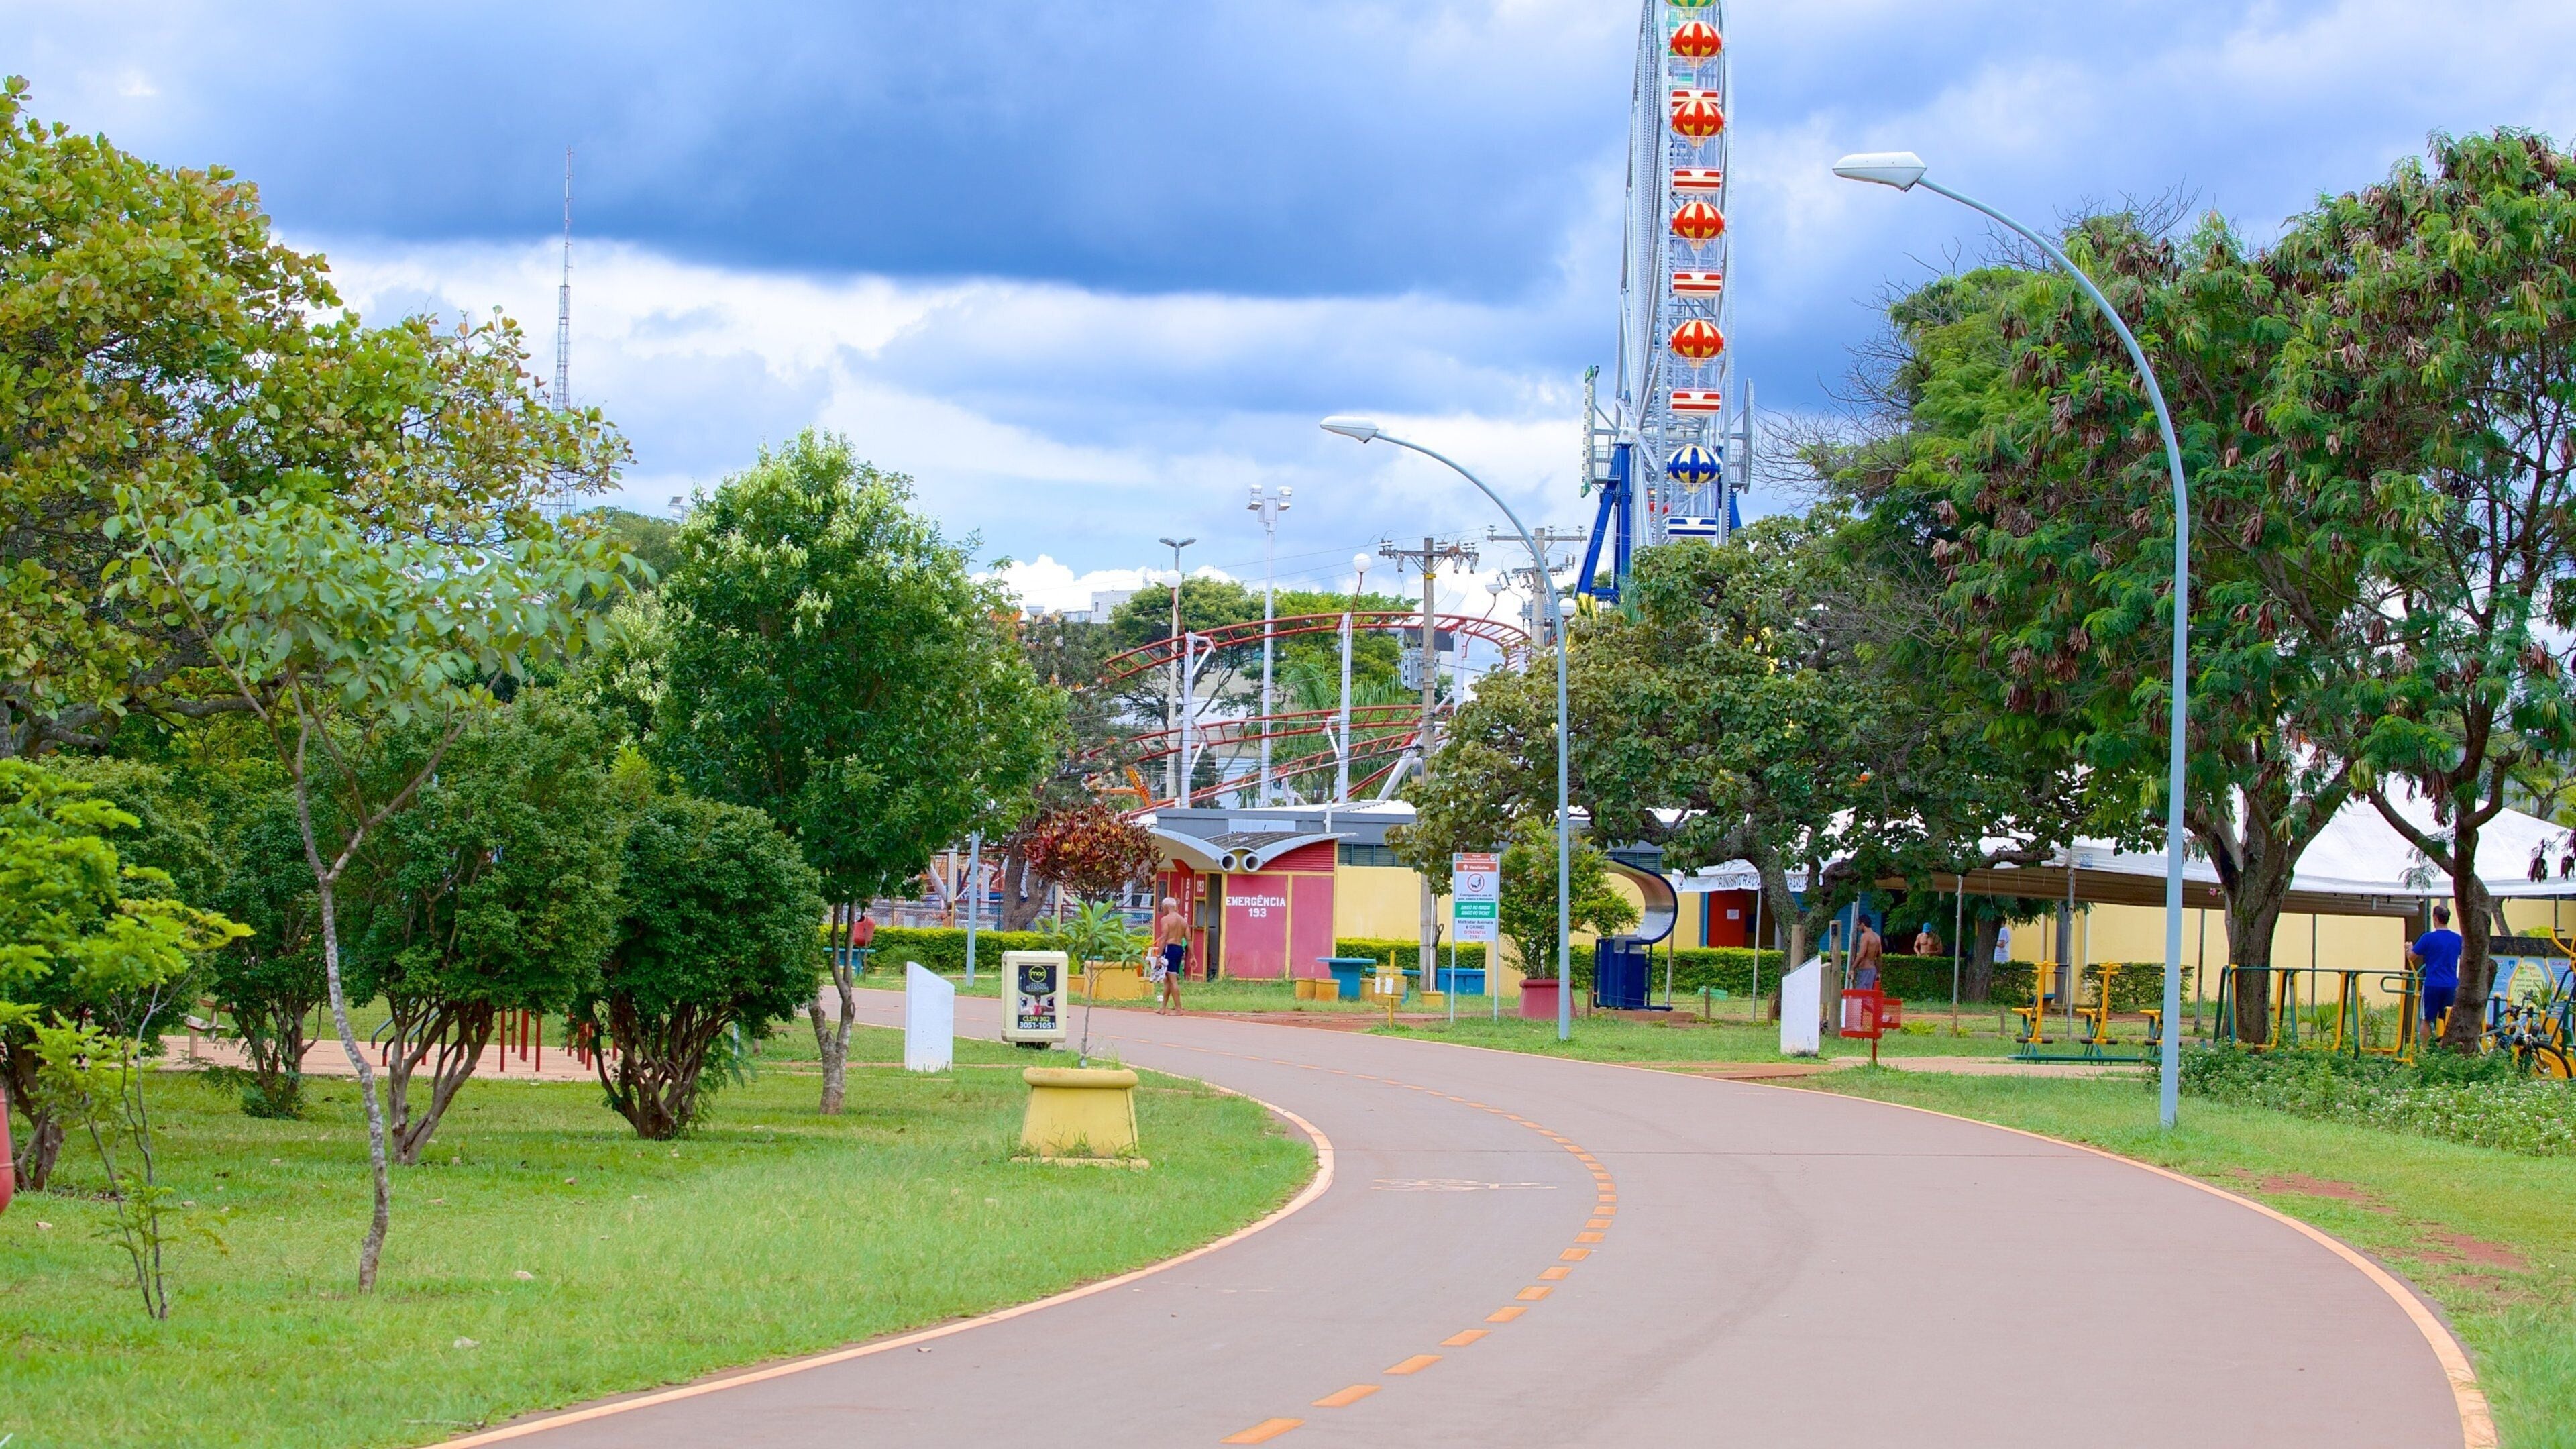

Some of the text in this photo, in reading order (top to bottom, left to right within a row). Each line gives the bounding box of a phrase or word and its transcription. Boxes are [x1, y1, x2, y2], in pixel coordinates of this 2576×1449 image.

[1196, 879, 1205, 892] 193
[1226, 894, 1286, 906] EMERGÊNCIA
[1248, 908, 1267, 918] 193
